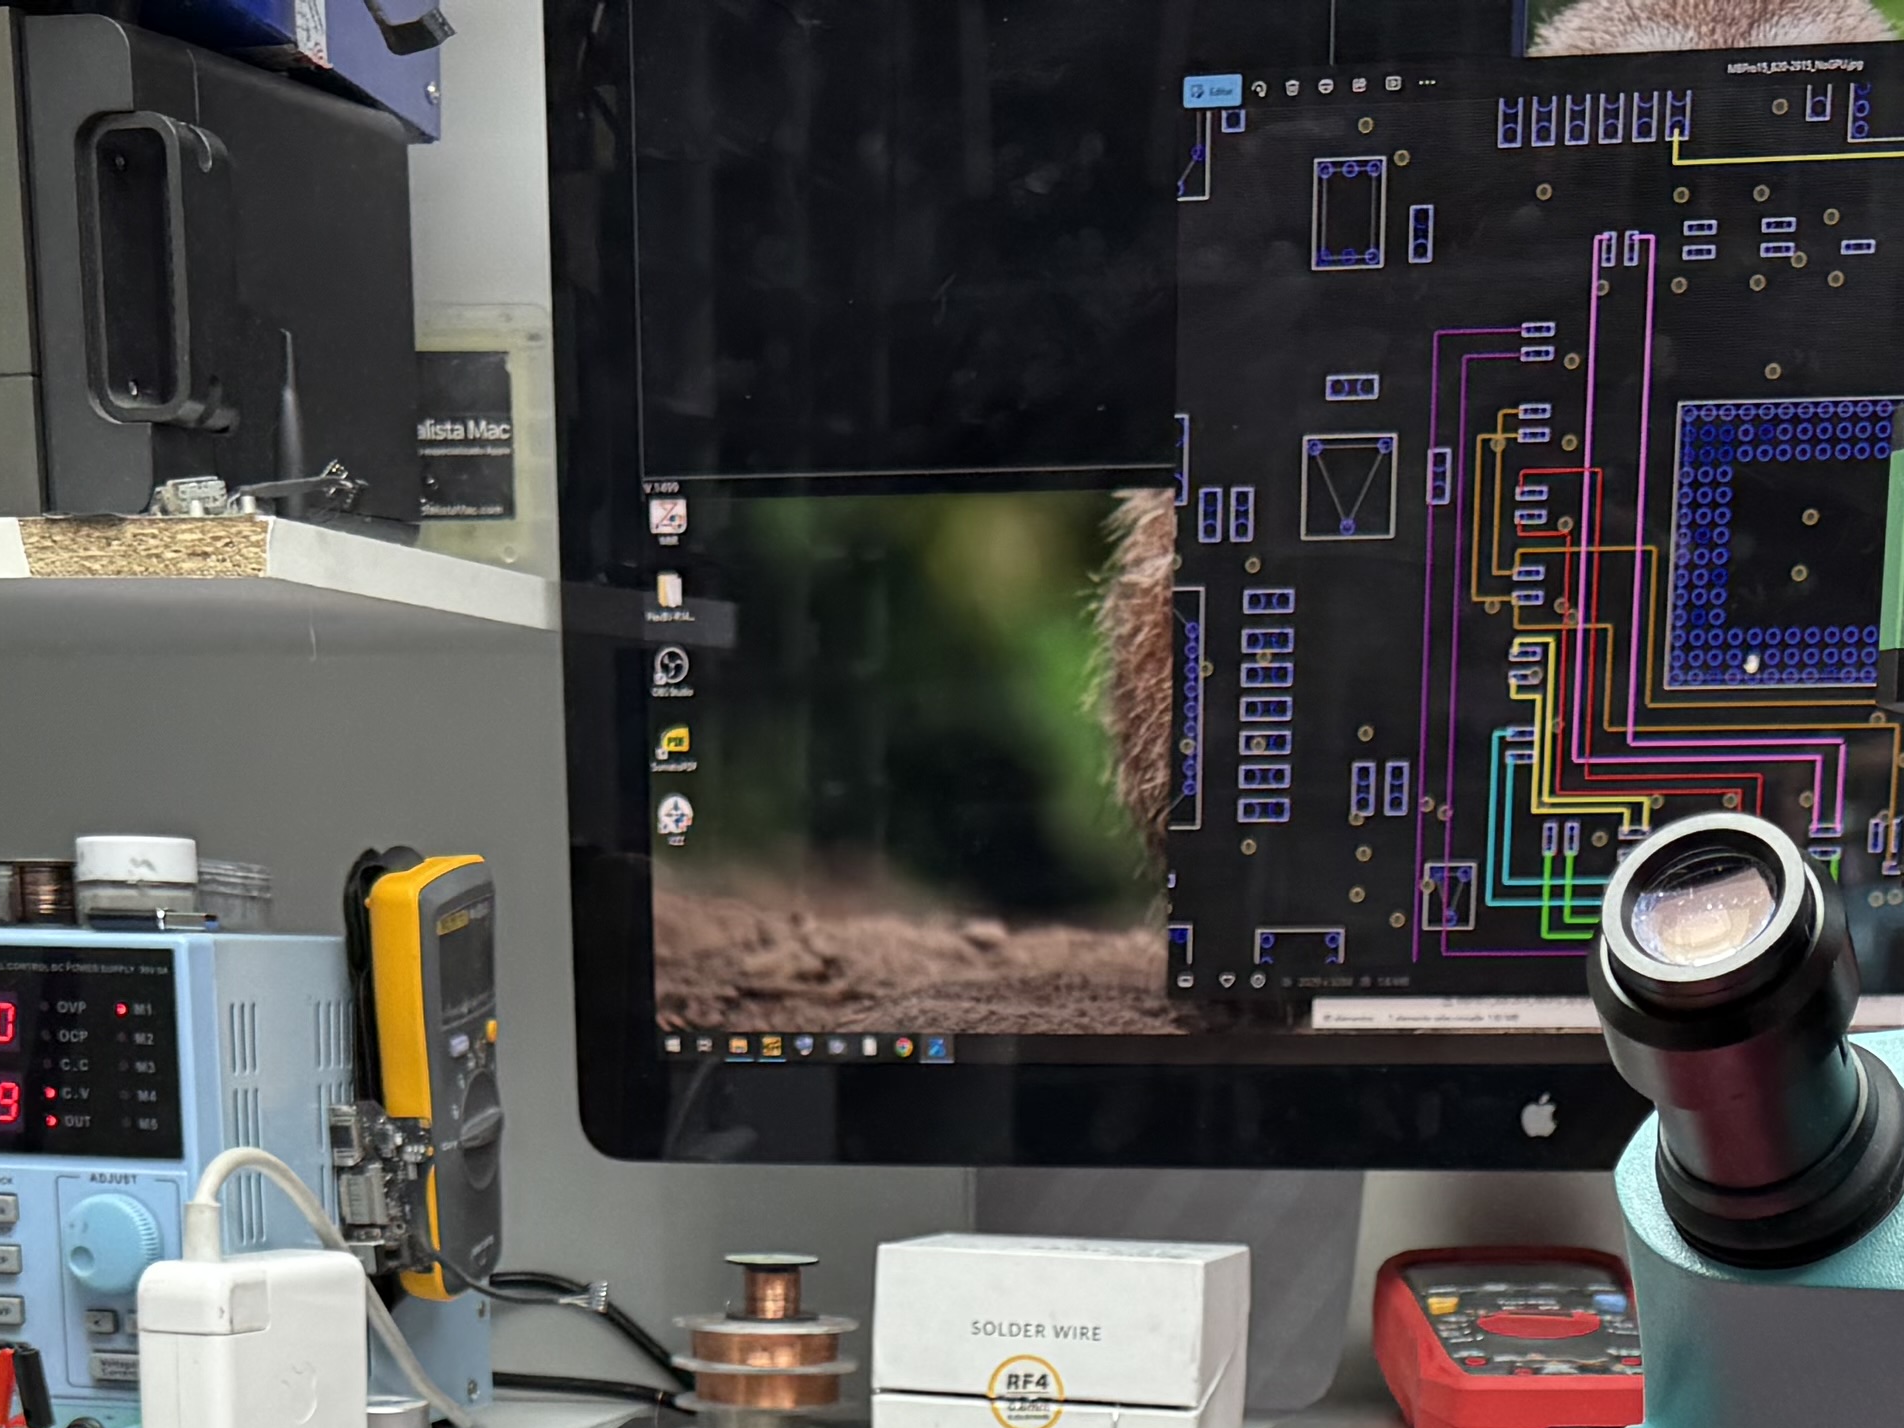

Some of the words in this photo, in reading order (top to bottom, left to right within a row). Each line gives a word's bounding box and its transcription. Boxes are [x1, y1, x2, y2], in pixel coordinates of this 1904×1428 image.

[467, 420, 510, 439] Mac
[57, 1001, 87, 1014] OVP
[133, 1004, 152, 1015] M1
[59, 1031, 88, 1043] OCP
[135, 1033, 154, 1045] M2
[137, 1062, 156, 1073] M3
[65, 1116, 91, 1127] OUT
[90, 1175, 137, 1184] ADJUST
[971, 1321, 1046, 1339] SOLDER
[1053, 1325, 1101, 1342] WIRE
[1006, 1373, 1050, 1390] RF4
